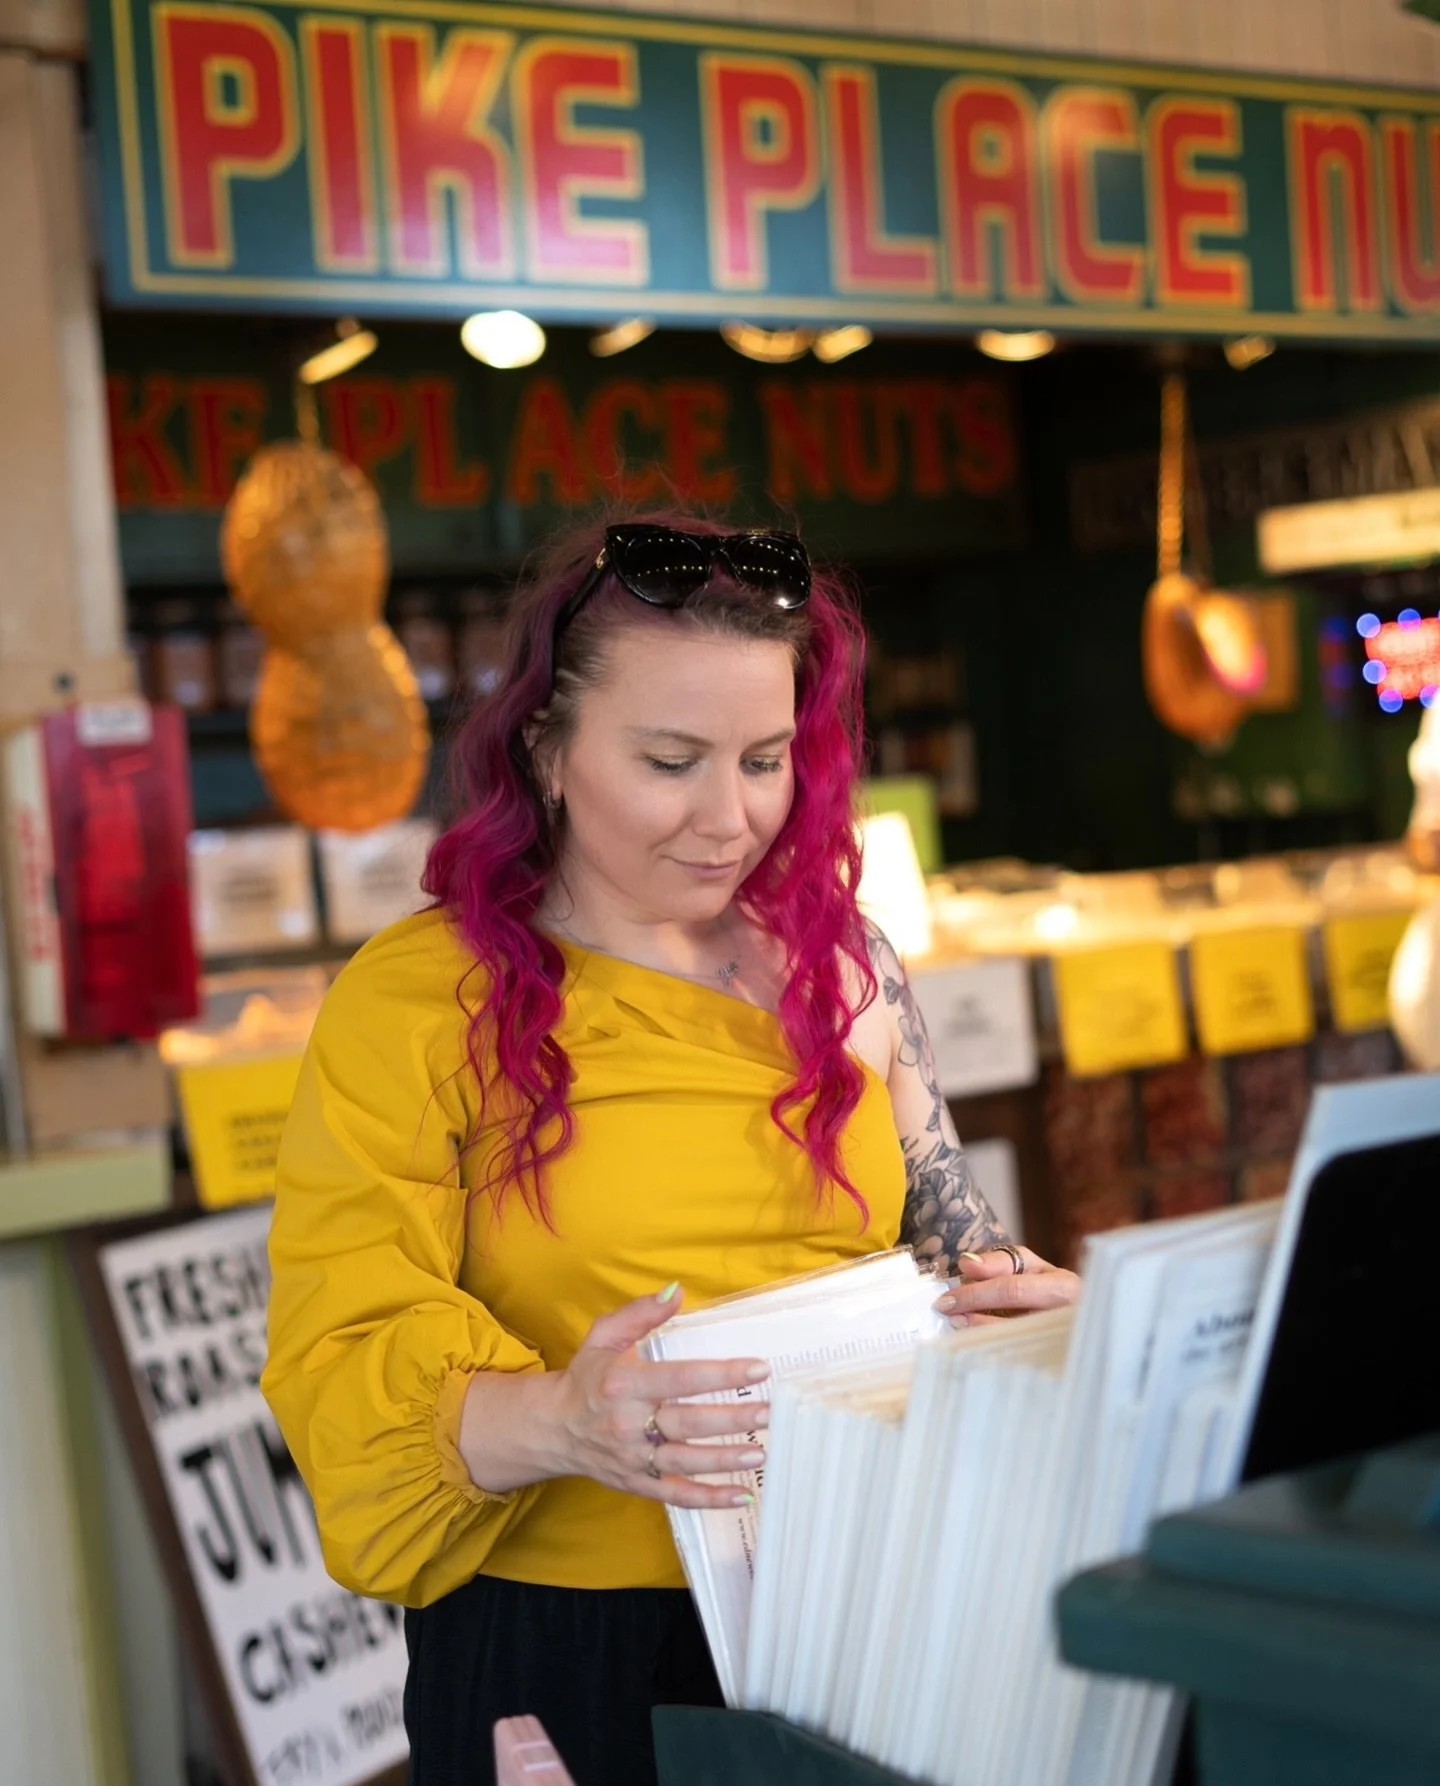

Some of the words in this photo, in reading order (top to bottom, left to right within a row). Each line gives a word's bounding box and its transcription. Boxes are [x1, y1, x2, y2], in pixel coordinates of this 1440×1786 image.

[152, 4, 651, 287] PIKE
[699, 50, 1255, 312] PLACE
[325, 374, 738, 509] PLACE
[760, 376, 1016, 502] NUTS
